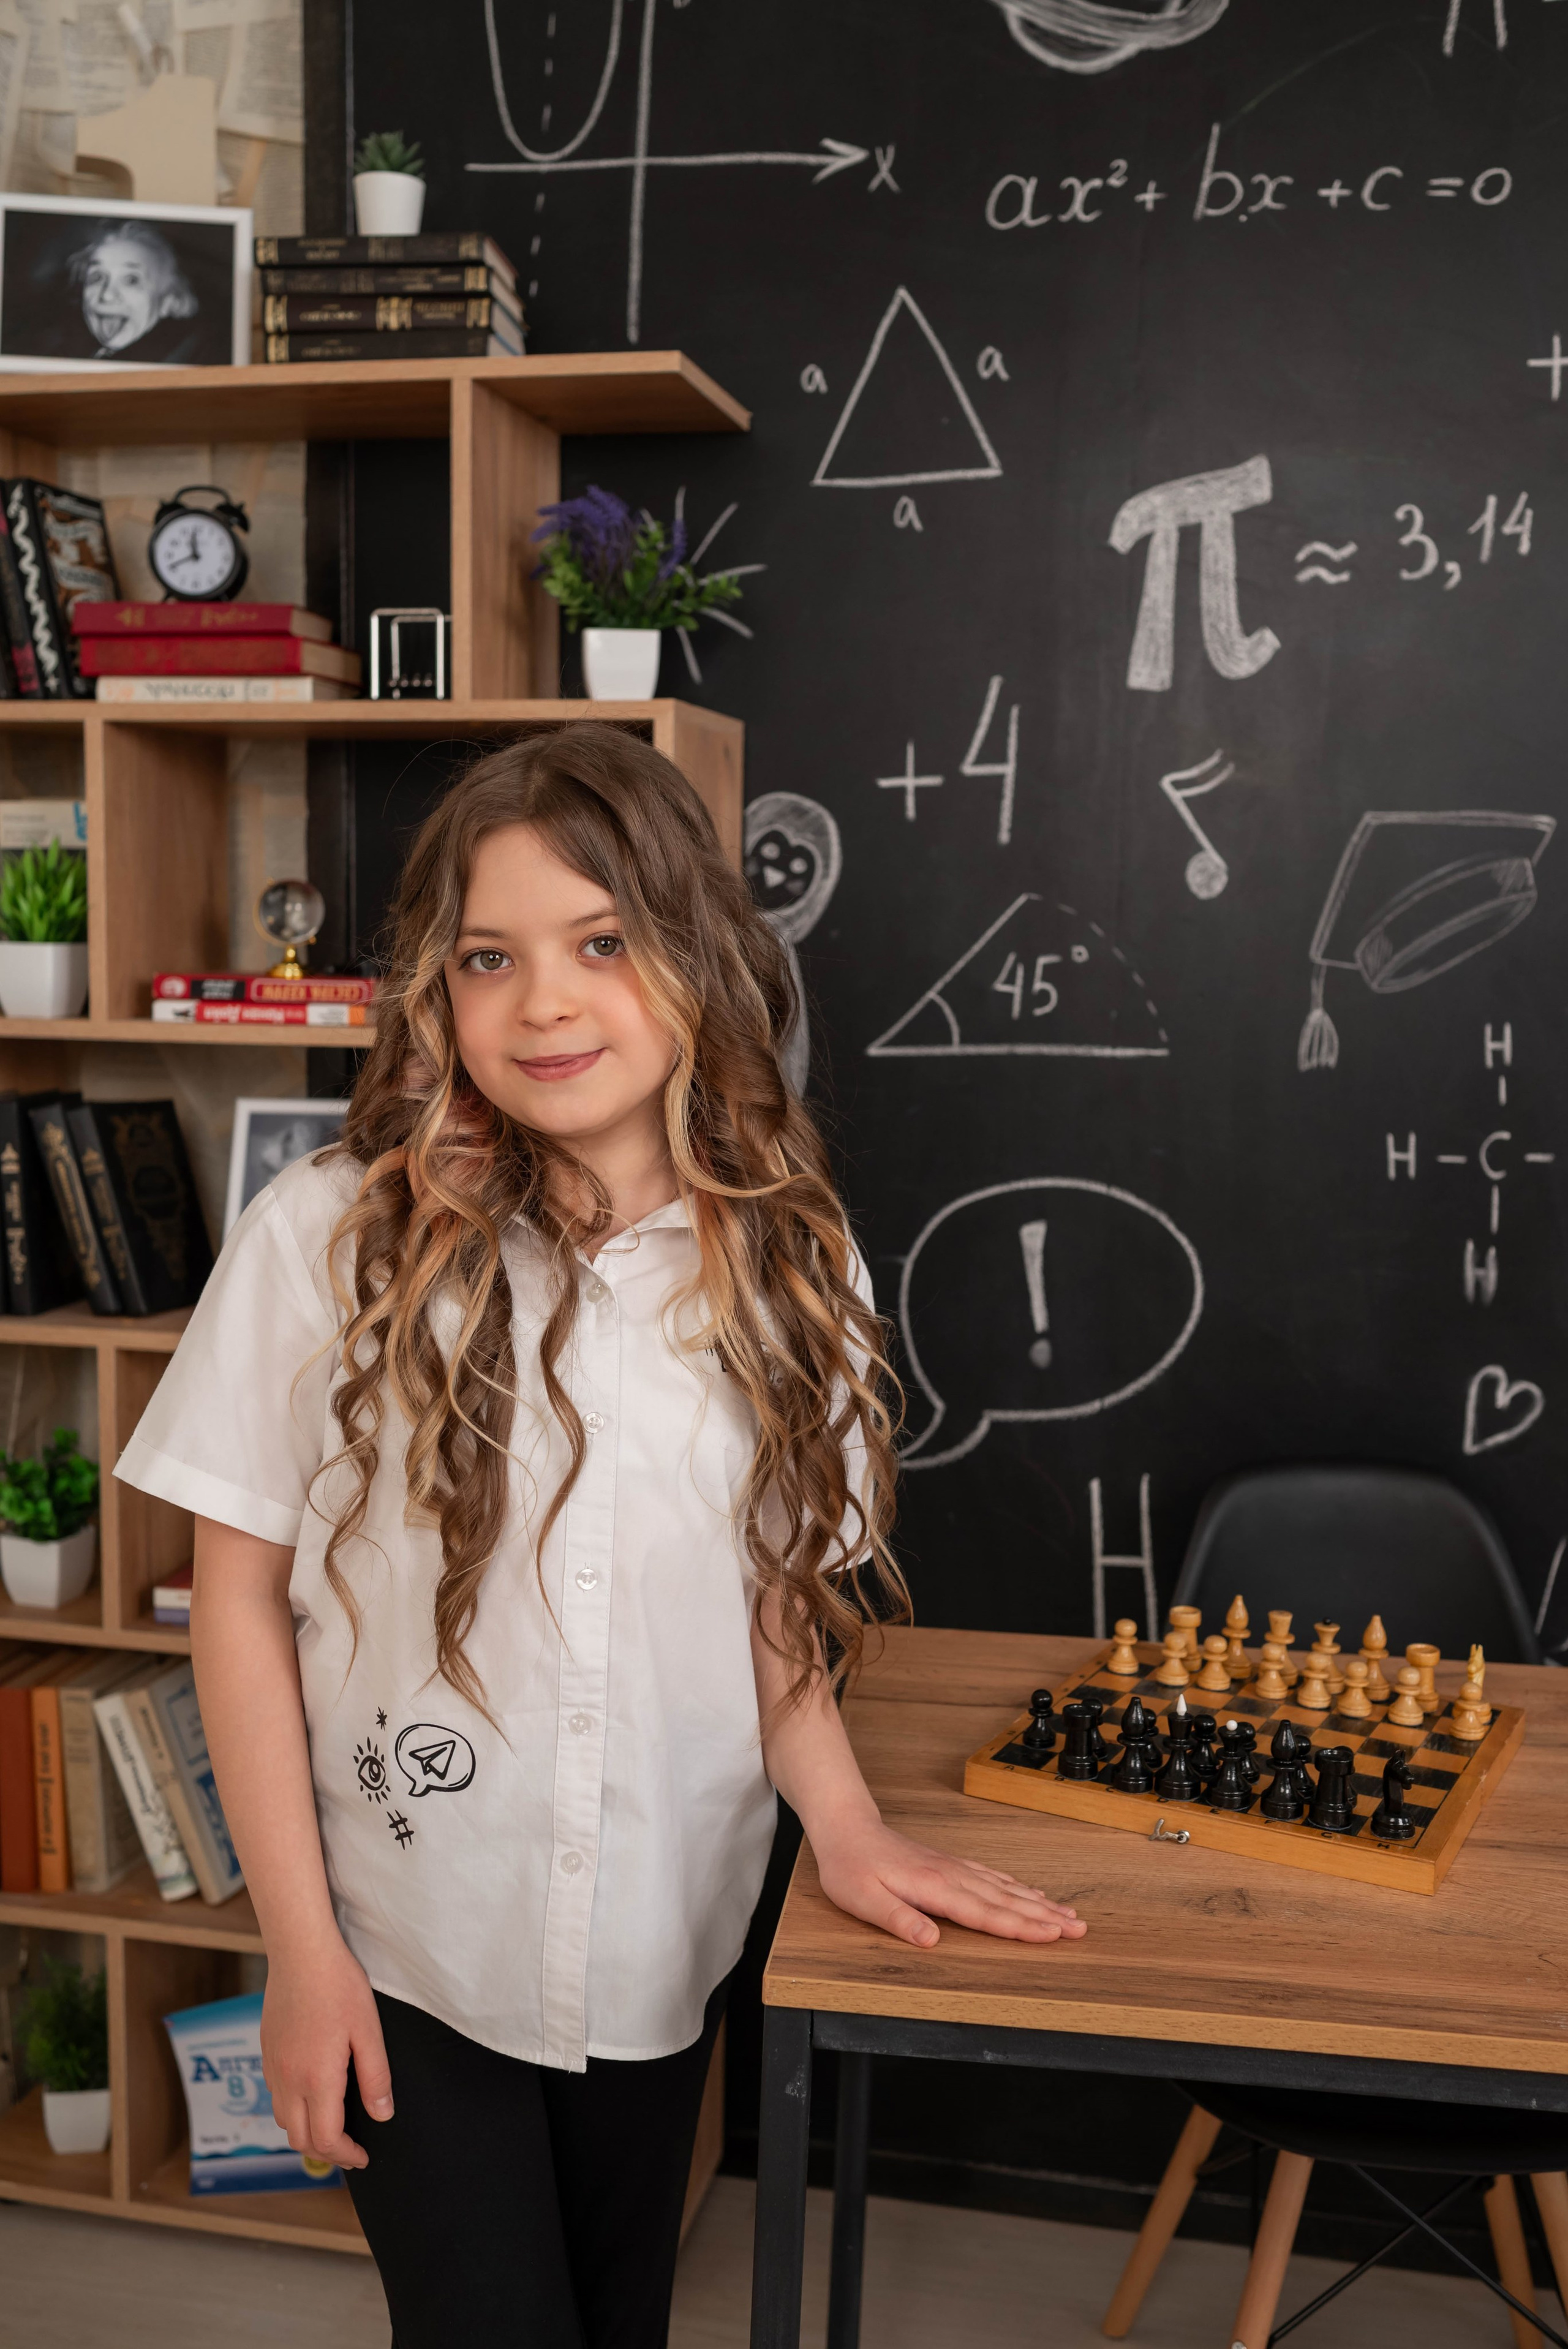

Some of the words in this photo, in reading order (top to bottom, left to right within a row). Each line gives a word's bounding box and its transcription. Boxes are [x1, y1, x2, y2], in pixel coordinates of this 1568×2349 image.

[800, 363, 828, 394] a
[976, 345, 1010, 382] a
[893, 495, 924, 532] a
[1394, 491, 1534, 590] 3,14
[1485, 1022, 1512, 1069] H
